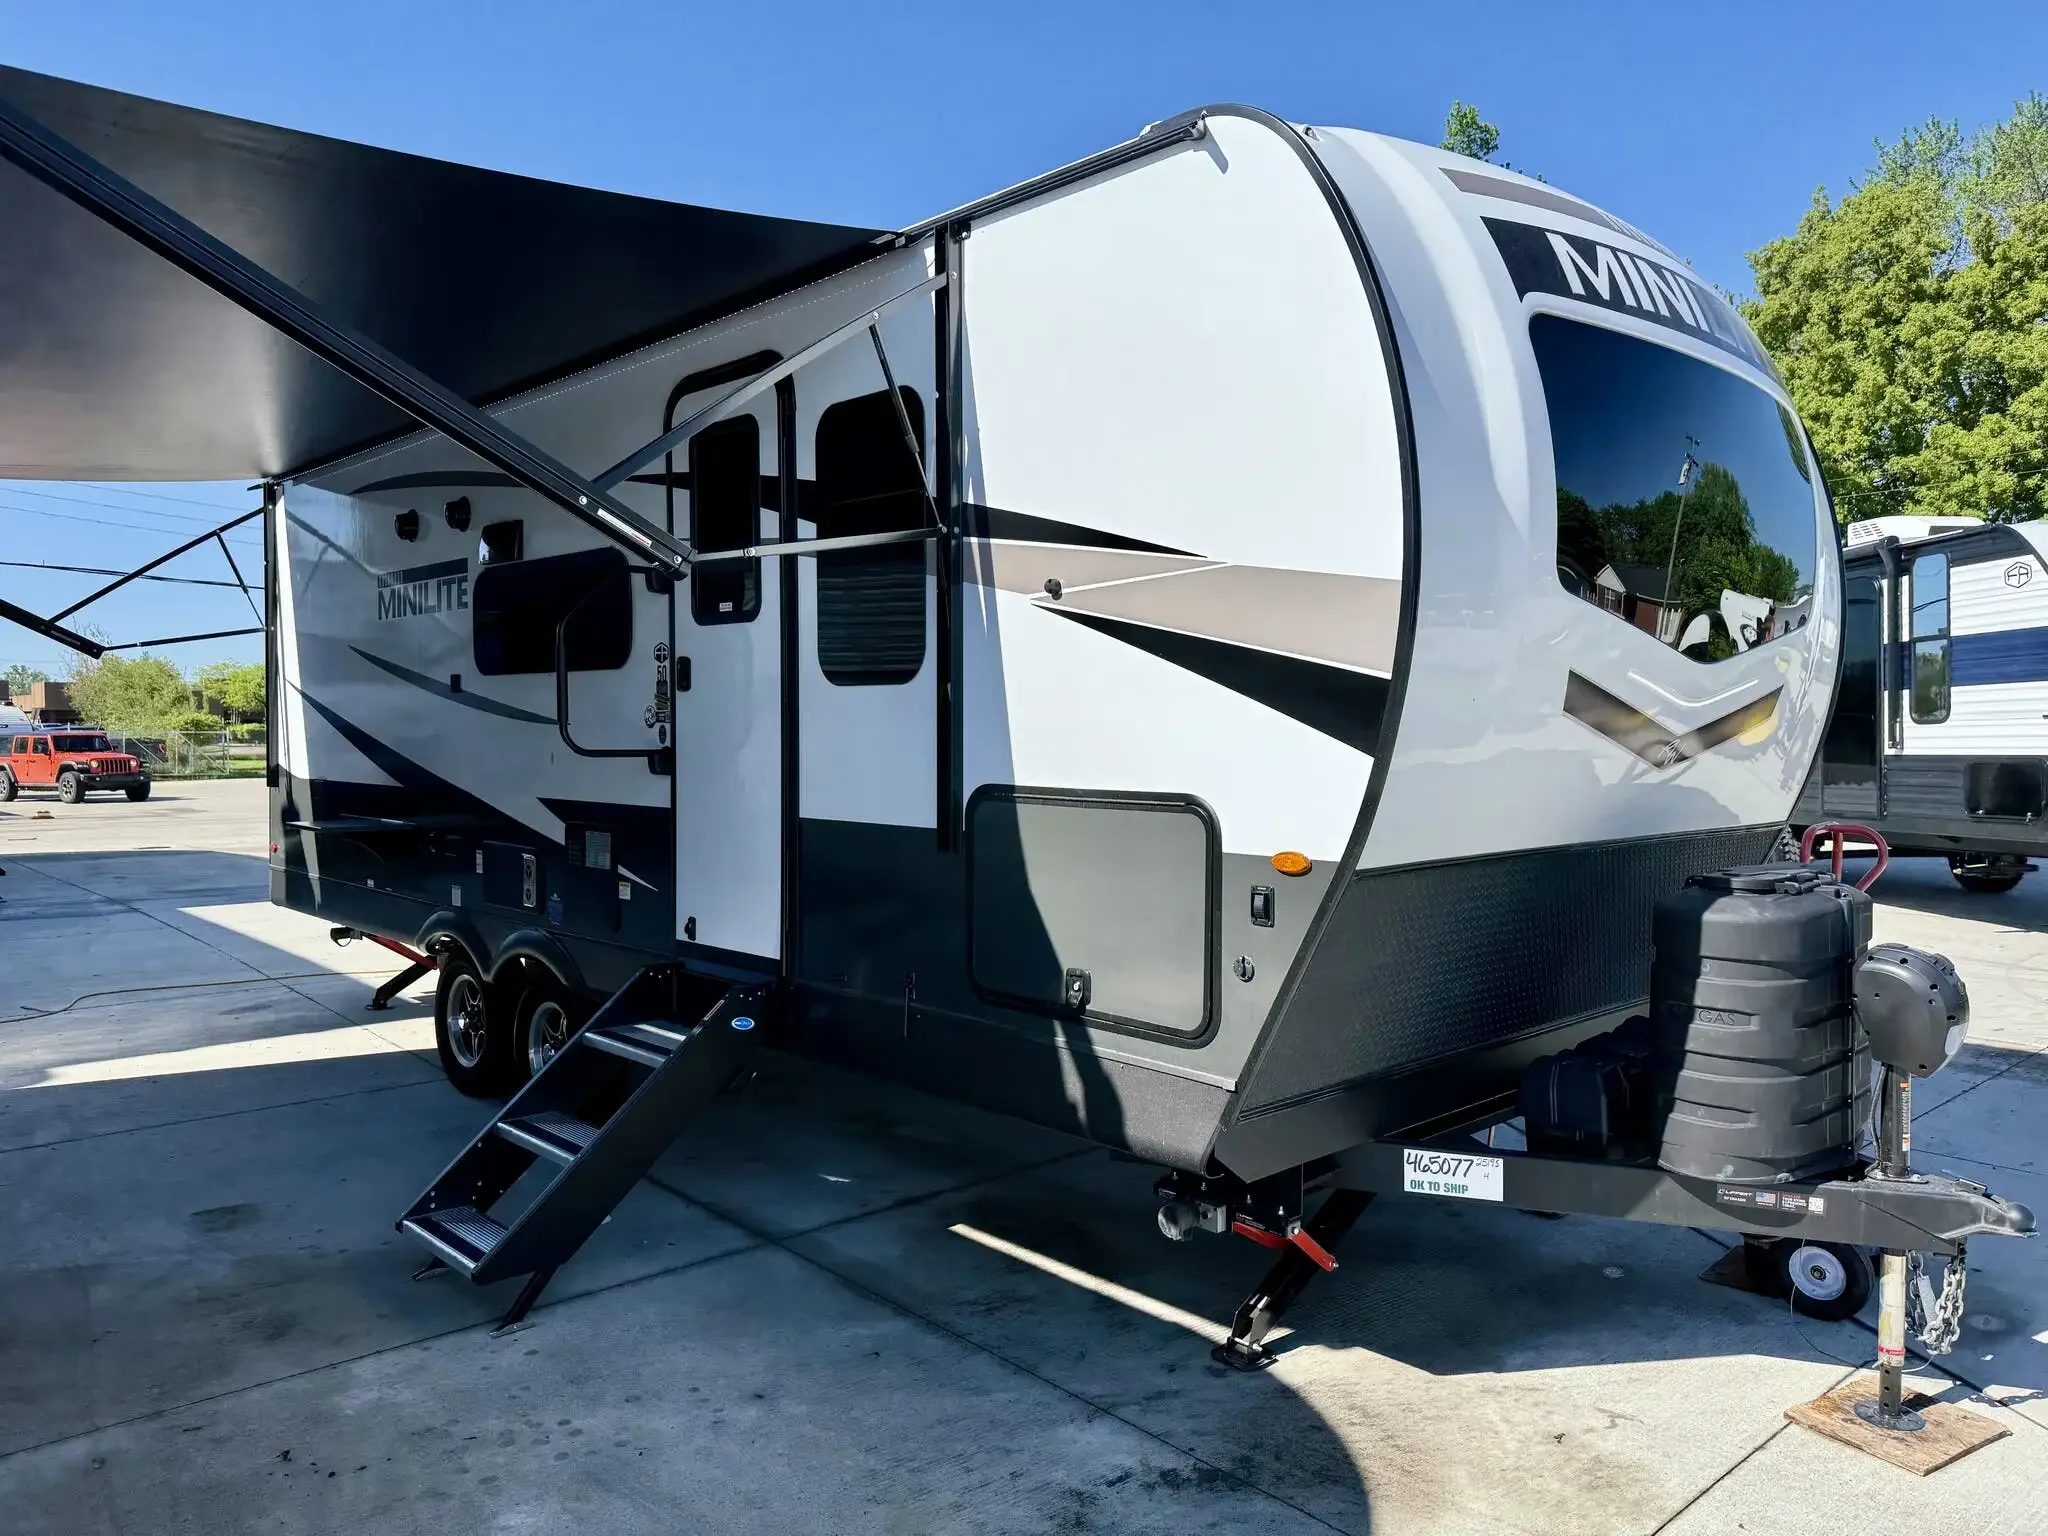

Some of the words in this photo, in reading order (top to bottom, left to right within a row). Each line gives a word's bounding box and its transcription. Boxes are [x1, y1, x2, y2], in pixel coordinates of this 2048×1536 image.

[377, 574, 469, 621] MINILITE
[1698, 1009, 1736, 1026] GAS
[1406, 1152, 1474, 1178] 465077
[1410, 1179, 1425, 1190] OK
[1427, 1181, 1440, 1192] TO
[1443, 1182, 1469, 1195] SHIP
